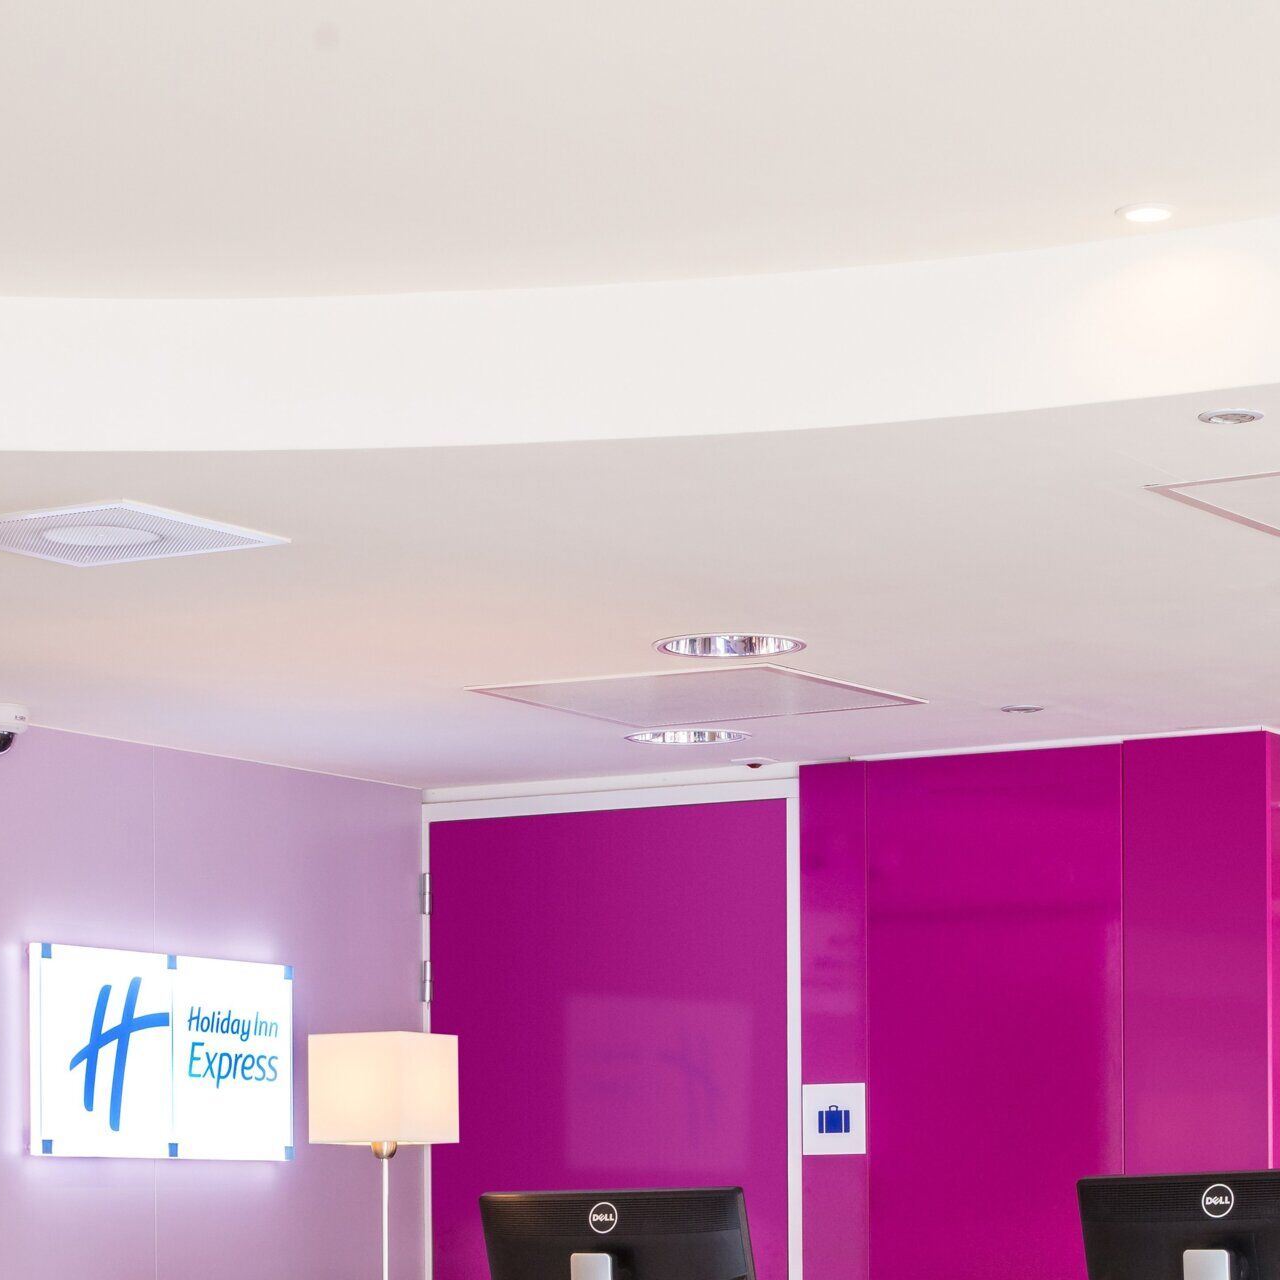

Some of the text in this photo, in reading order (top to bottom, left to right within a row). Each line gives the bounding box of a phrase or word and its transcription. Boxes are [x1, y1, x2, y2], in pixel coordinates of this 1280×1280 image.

[187, 1006, 279, 1042] Holiday Inn
[188, 1041, 279, 1089] Express
[1205, 1196, 1230, 1205] DELL
[592, 1213, 615, 1222] DELL
